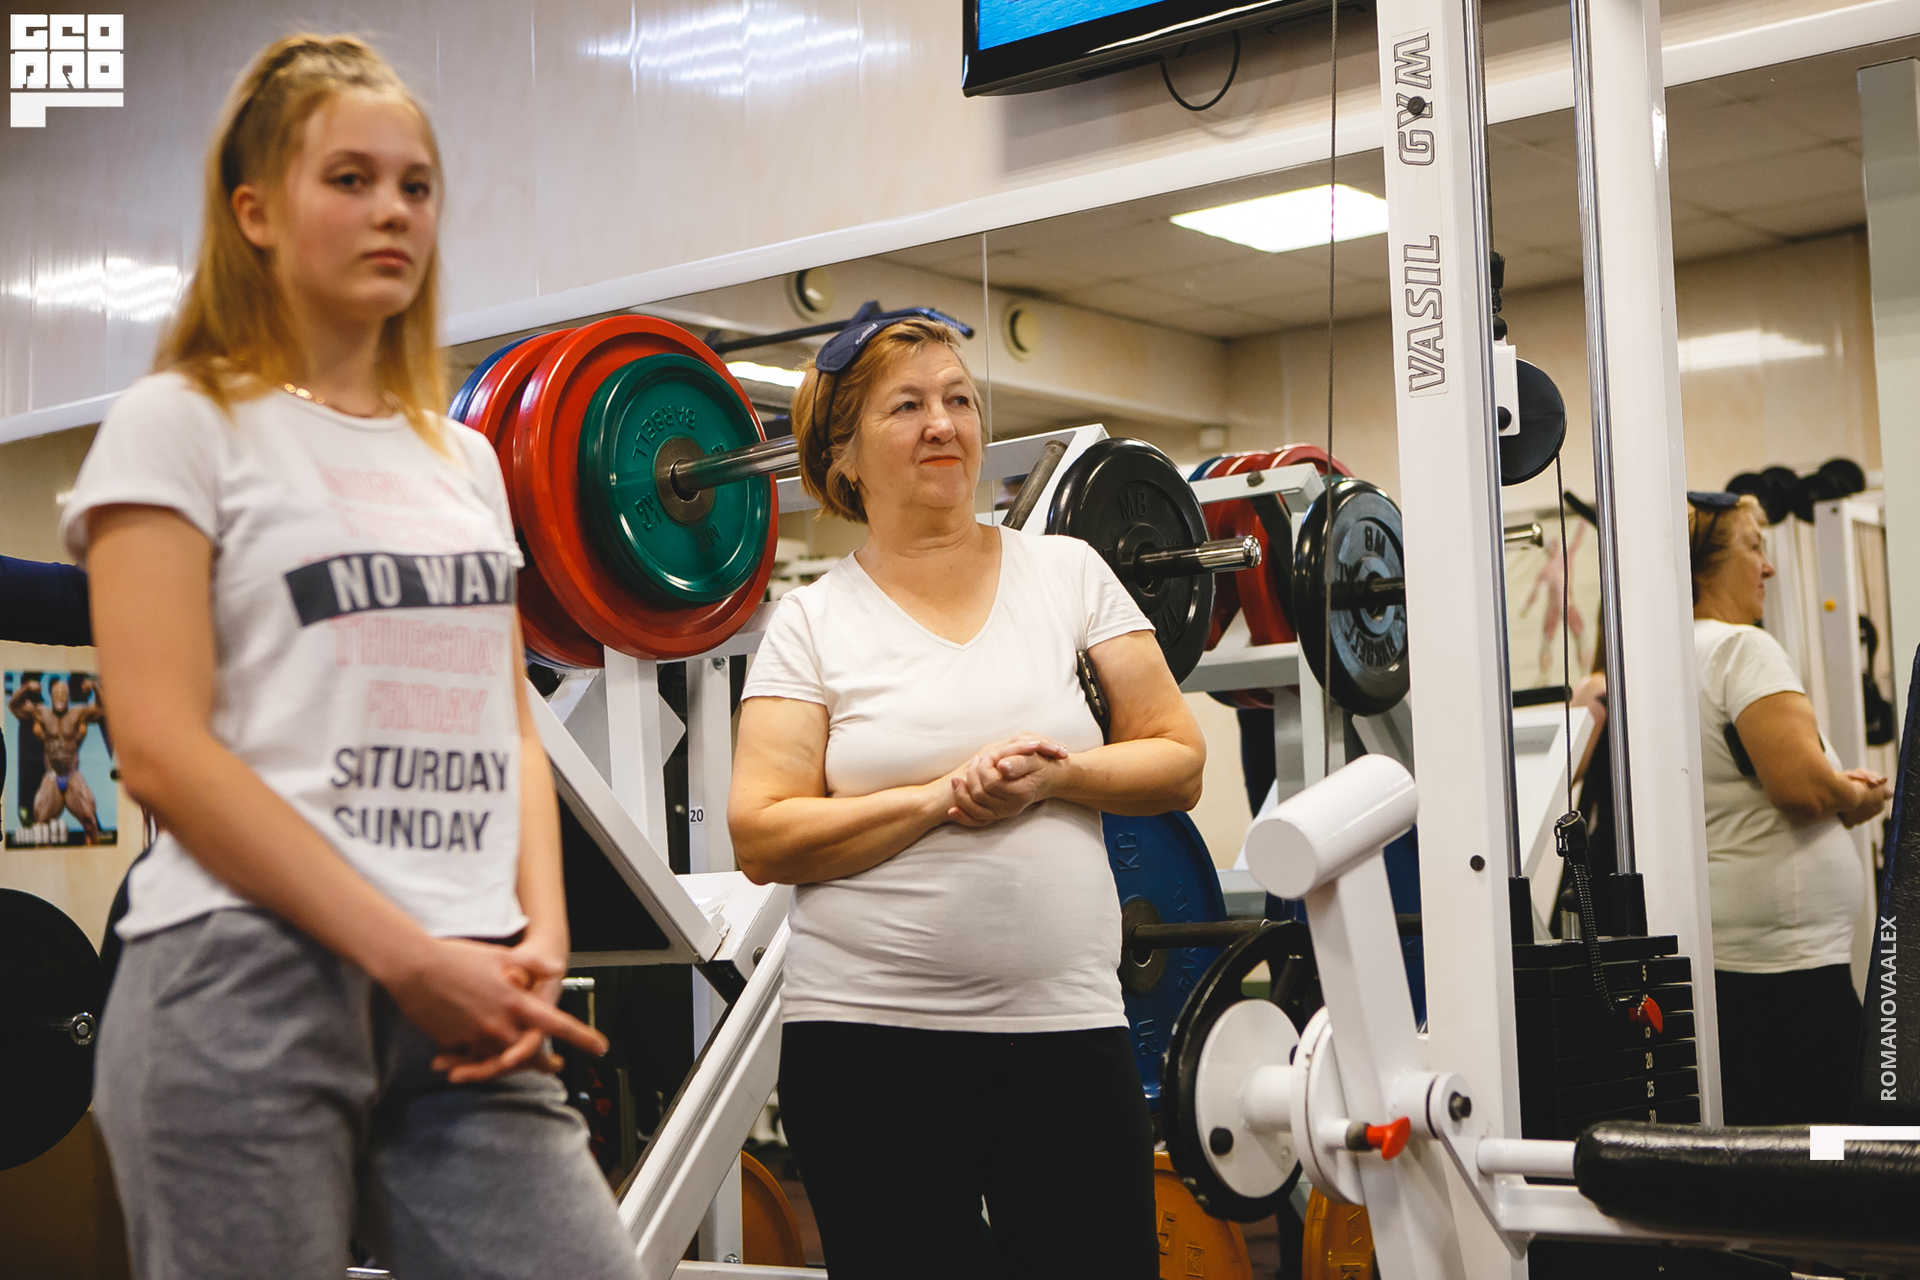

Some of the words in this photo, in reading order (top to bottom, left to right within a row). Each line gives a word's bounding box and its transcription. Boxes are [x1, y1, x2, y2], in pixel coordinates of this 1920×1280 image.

[1393, 32, 1436, 167] GYM
[1403, 234, 1446, 393] VASIL
[631, 405, 697, 460] BARBELL
[1118, 489, 1148, 522] MB
[327, 553, 403, 613] NO
[413, 553, 510, 606] WAY
[333, 805, 492, 852] SUNDAY
[689, 808, 704, 823] 20
[1115, 832, 1140, 872] KG
[1641, 964, 1648, 982] 5
[1136, 1018, 1158, 1058] 20
[1645, 1052, 1654, 1070] 20
[1646, 1080, 1655, 1098] 25
